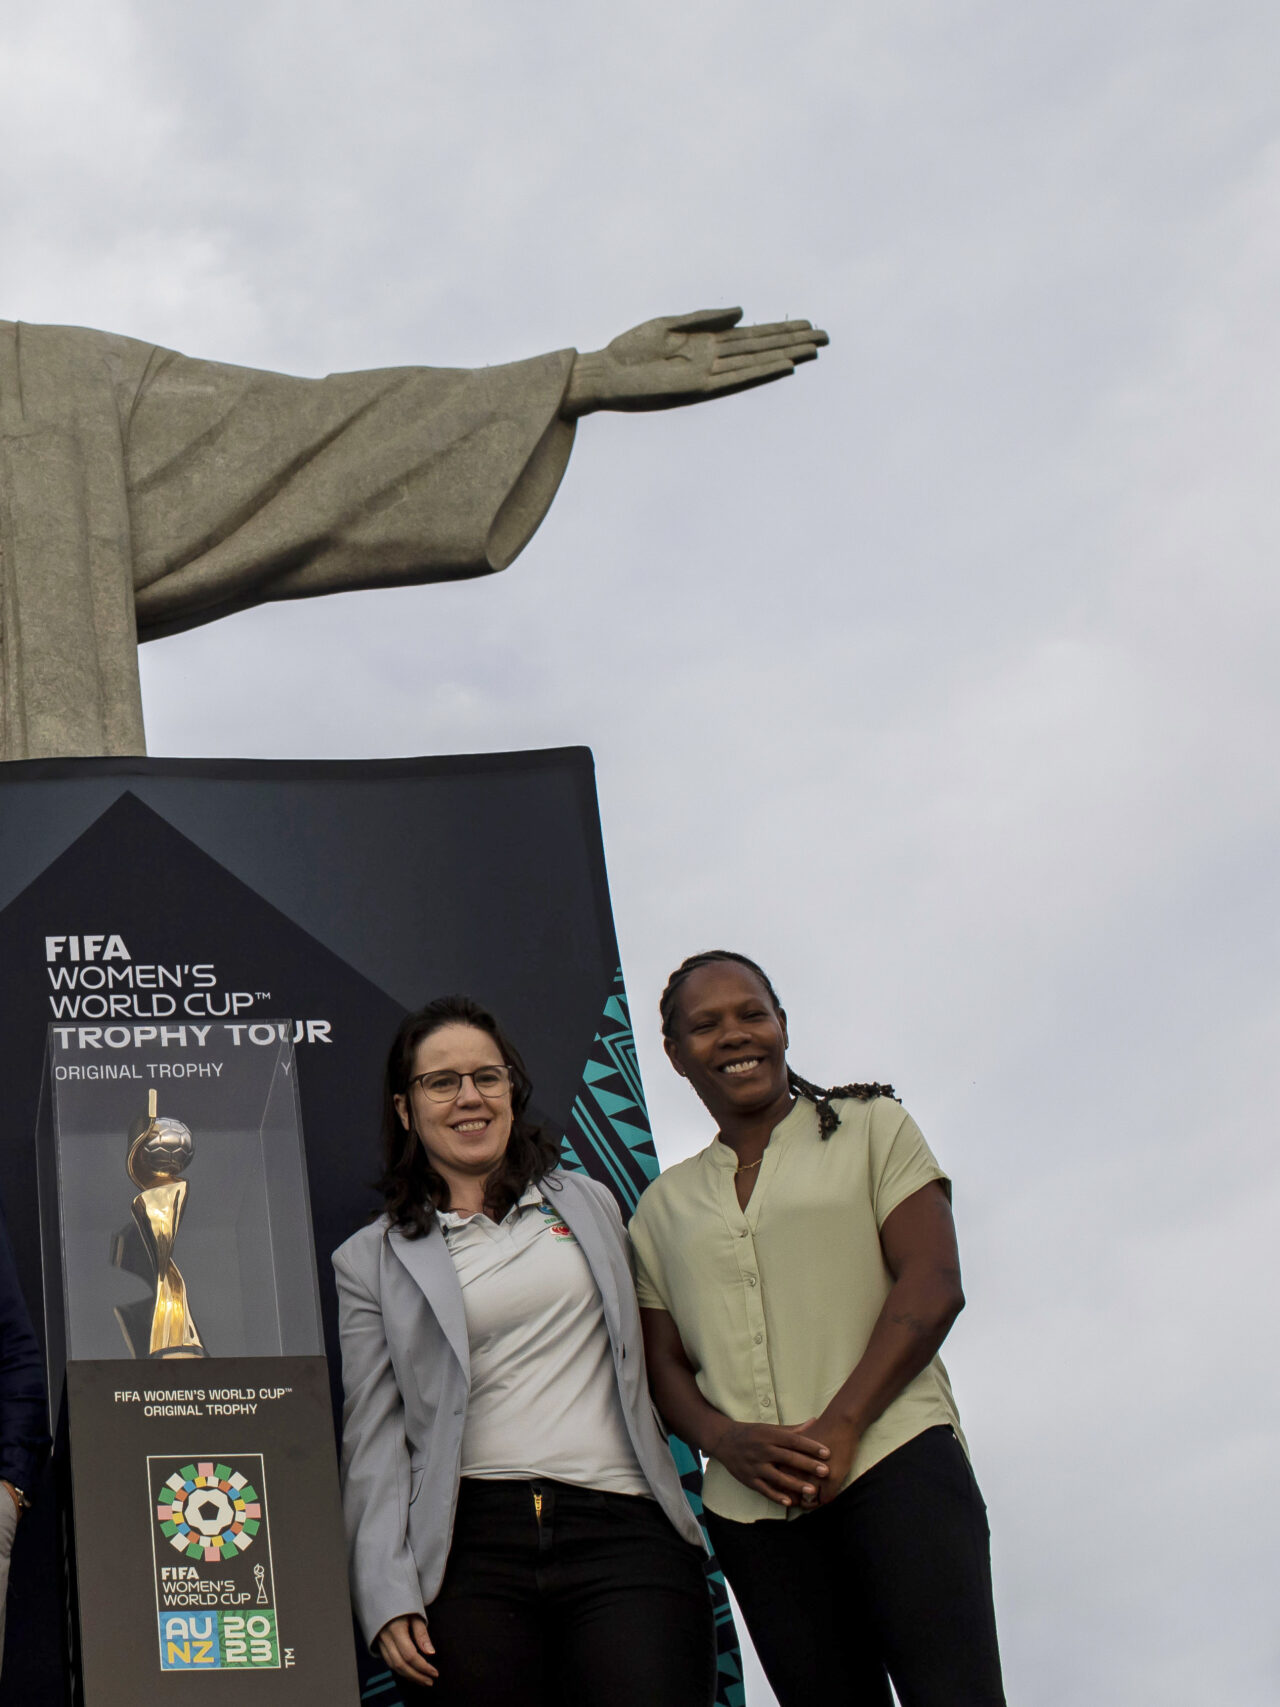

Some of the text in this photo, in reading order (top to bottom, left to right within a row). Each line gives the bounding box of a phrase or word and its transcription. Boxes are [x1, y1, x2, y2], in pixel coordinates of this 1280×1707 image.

[45, 934, 131, 962] FIFA
[47, 964, 216, 990] WOMEN'S
[49, 995, 176, 1019] WORLD
[53, 1020, 333, 1049] TROPHY TOUR
[55, 1062, 223, 1080] ORIGINAL TROPHY
[114, 1391, 141, 1402] FIFA
[143, 1389, 205, 1402] WOMEN'S
[208, 1388, 256, 1400] WORLD
[144, 1404, 257, 1417] ORIGINAL TROPHY
[161, 1567, 199, 1580] FIFA
[162, 1580, 235, 1593] WOMEN'S
[163, 1593, 251, 1606] WORLD CUP
[166, 1616, 271, 1640] AU 20
[167, 1639, 272, 1664] NZ 23
